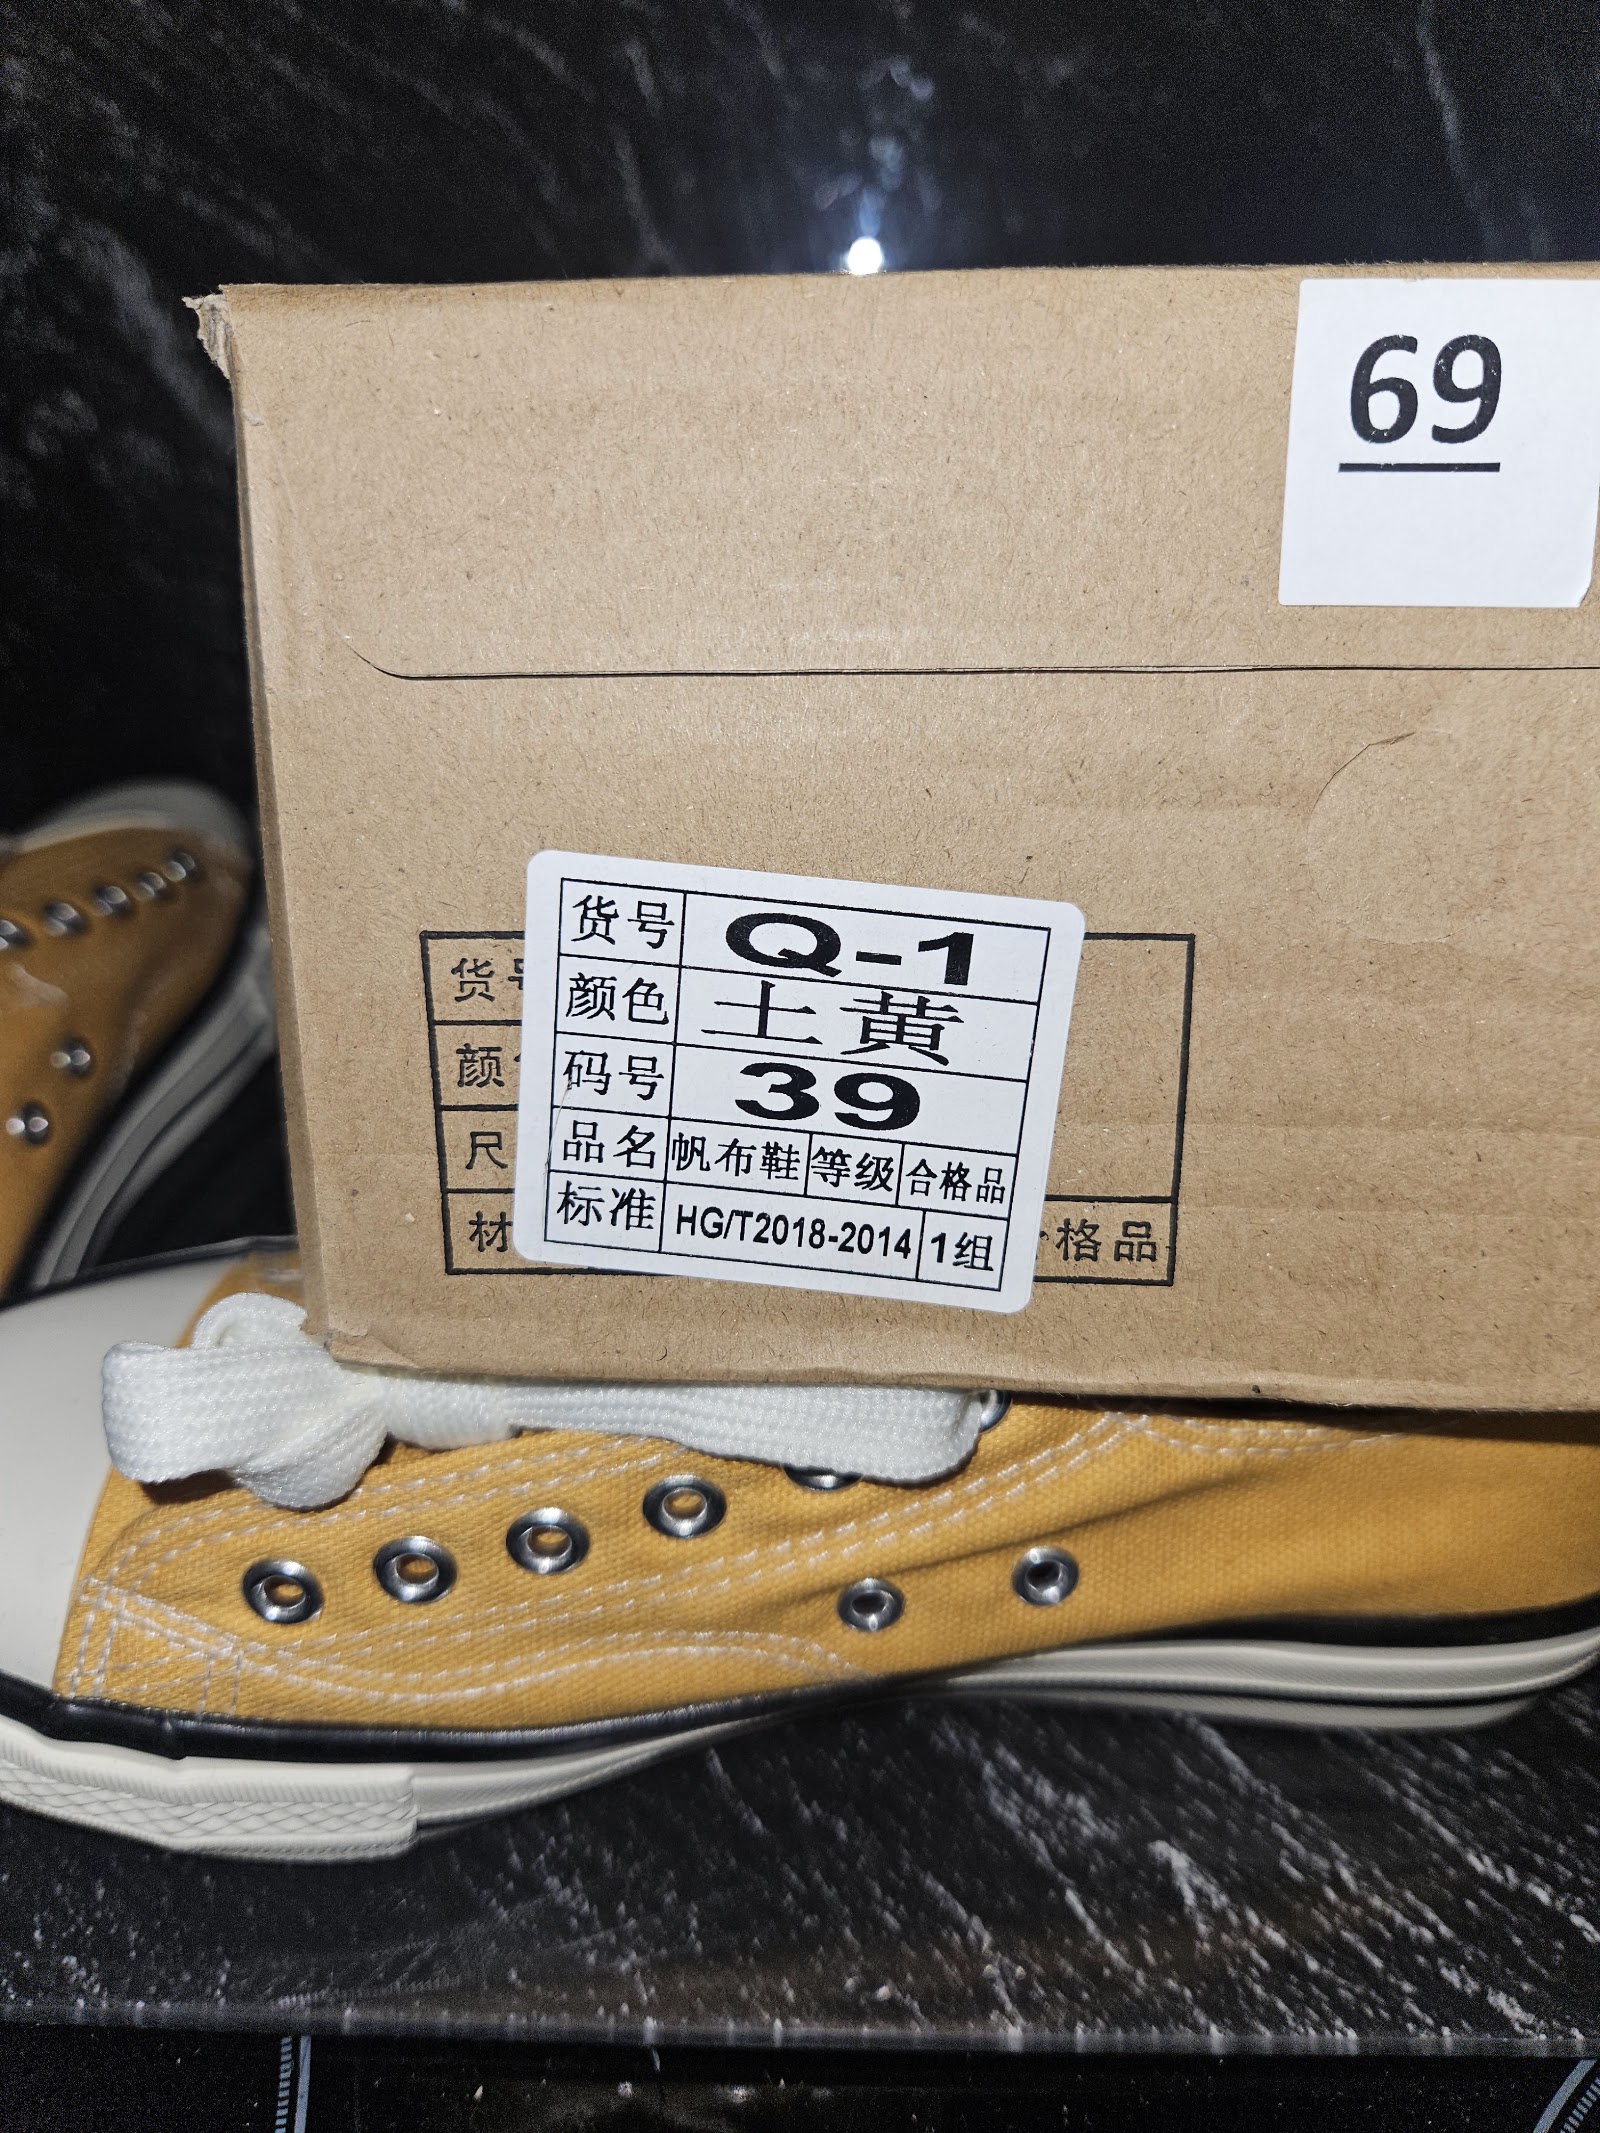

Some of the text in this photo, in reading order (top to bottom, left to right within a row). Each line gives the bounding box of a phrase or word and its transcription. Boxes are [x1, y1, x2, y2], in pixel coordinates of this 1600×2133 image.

[1350, 334, 1501, 444] 69
[571, 893, 976, 986] 货号 Q-1
[566, 972, 965, 1067] 颜色 土黄
[562, 1050, 920, 1131] 码号 39
[562, 1120, 1007, 1205] 品名 帆布鞋 等级 合格品
[557, 1181, 994, 1272] 标准 HG/T2018-2014 1组
[1035, 1217, 1158, 1262] 格品
